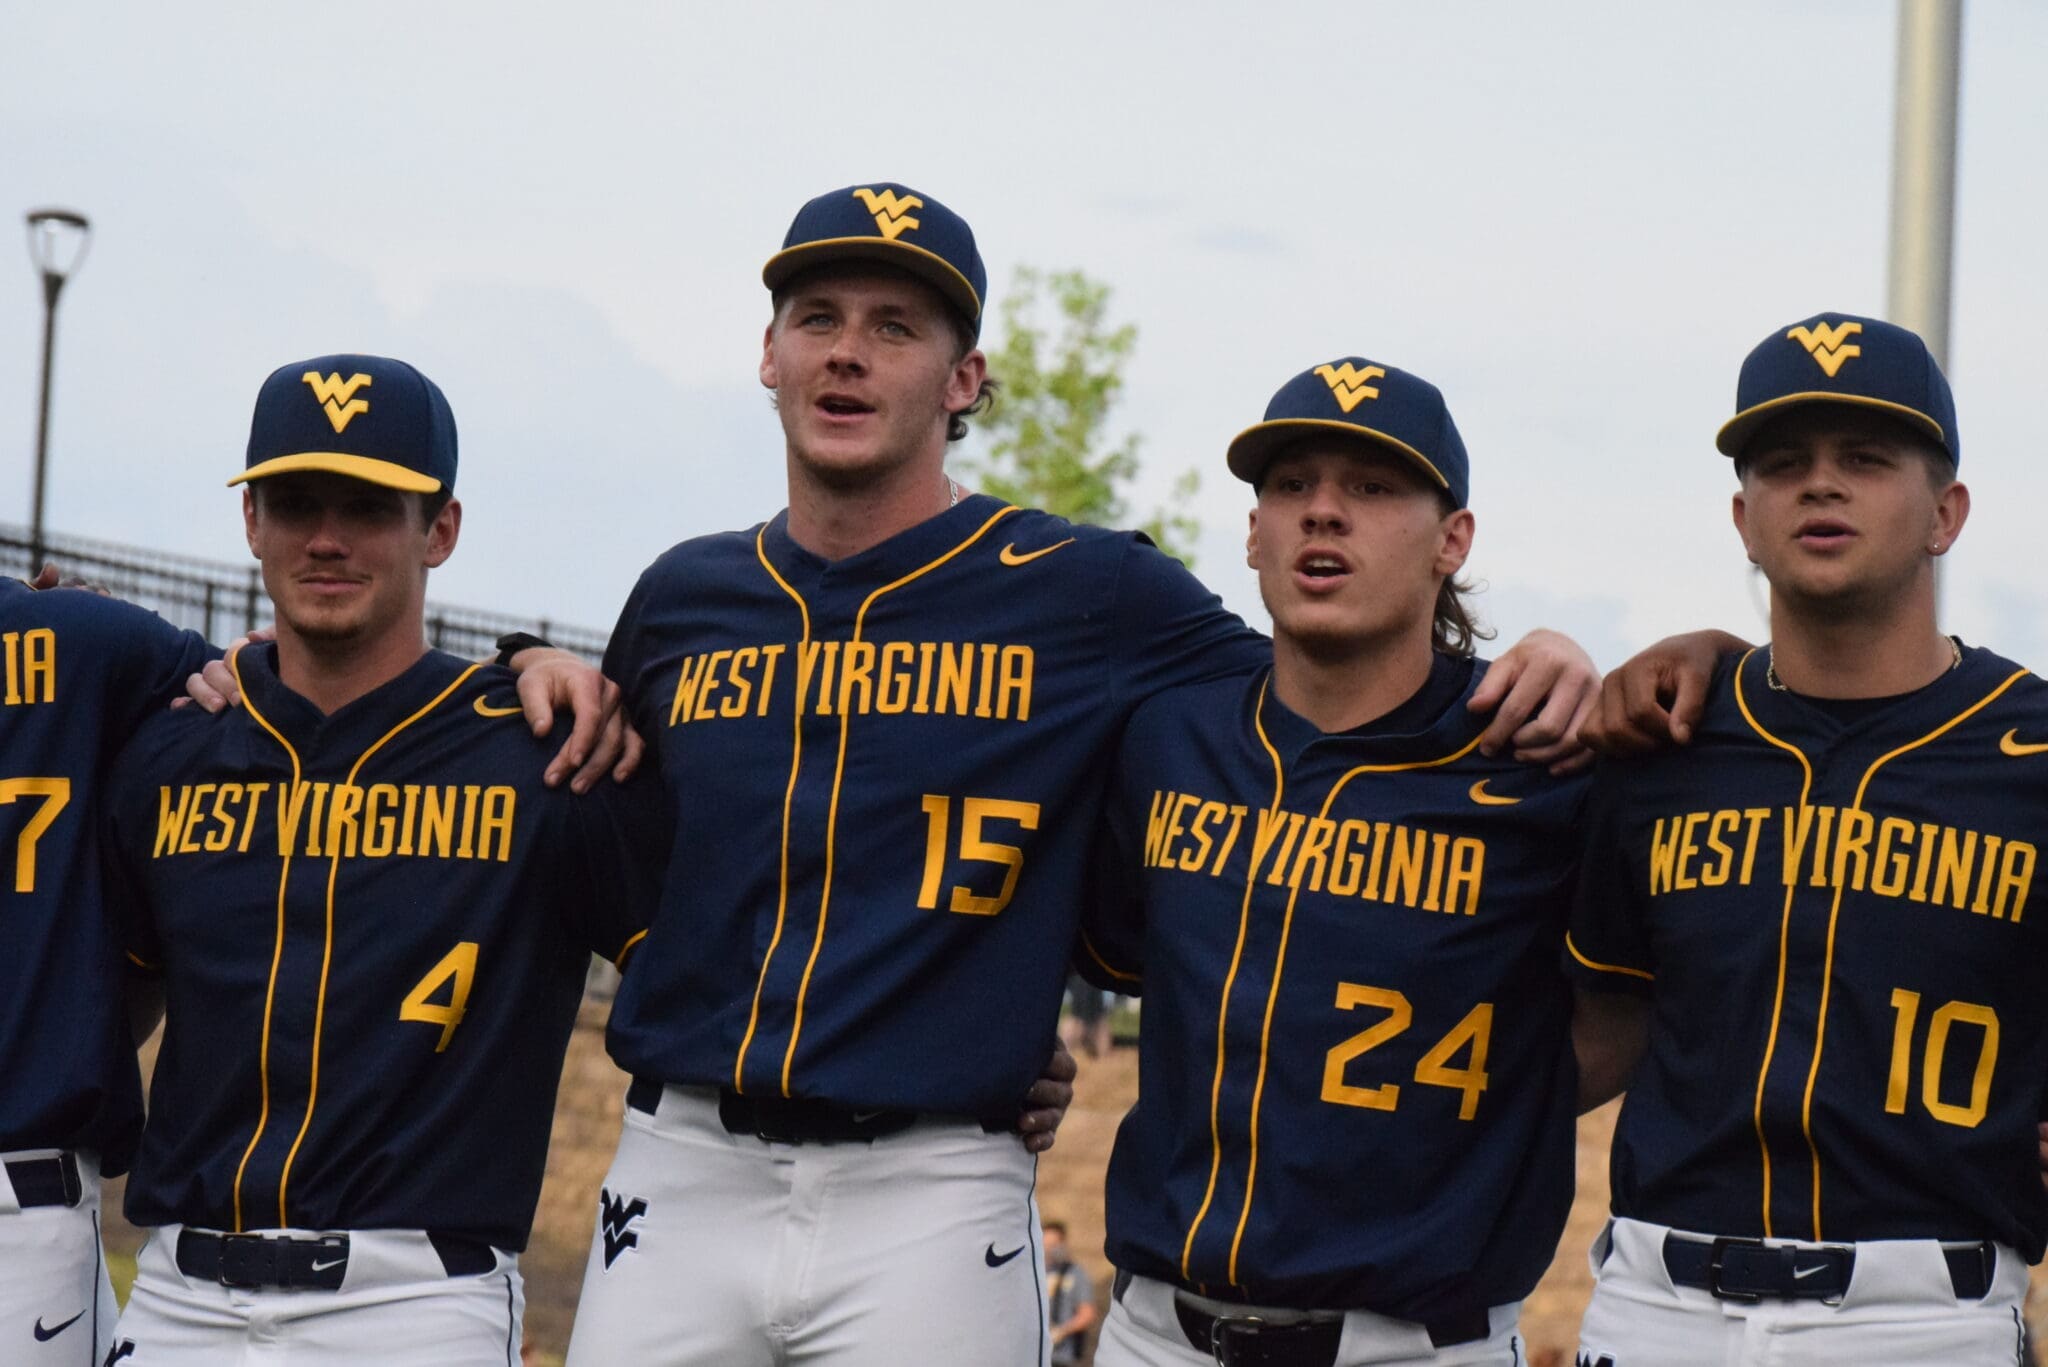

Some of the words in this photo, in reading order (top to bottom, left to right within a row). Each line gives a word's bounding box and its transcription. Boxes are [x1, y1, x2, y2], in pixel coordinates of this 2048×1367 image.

[2, 627, 57, 706] IA
[669, 642, 787, 728] WEST
[796, 640, 1034, 722] VIRGINIA
[152, 782, 271, 859] WEST
[276, 779, 517, 863] VIRGINIA
[916, 793, 1041, 916] 15
[1144, 790, 1249, 877] WEST
[1246, 808, 1487, 916] VIRGINIA
[1649, 806, 1772, 897] WEST
[1781, 804, 2038, 924] VIRGINIA
[398, 940, 481, 1055] 4
[1319, 981, 1495, 1122] 24
[1883, 986, 2001, 1129] 10
